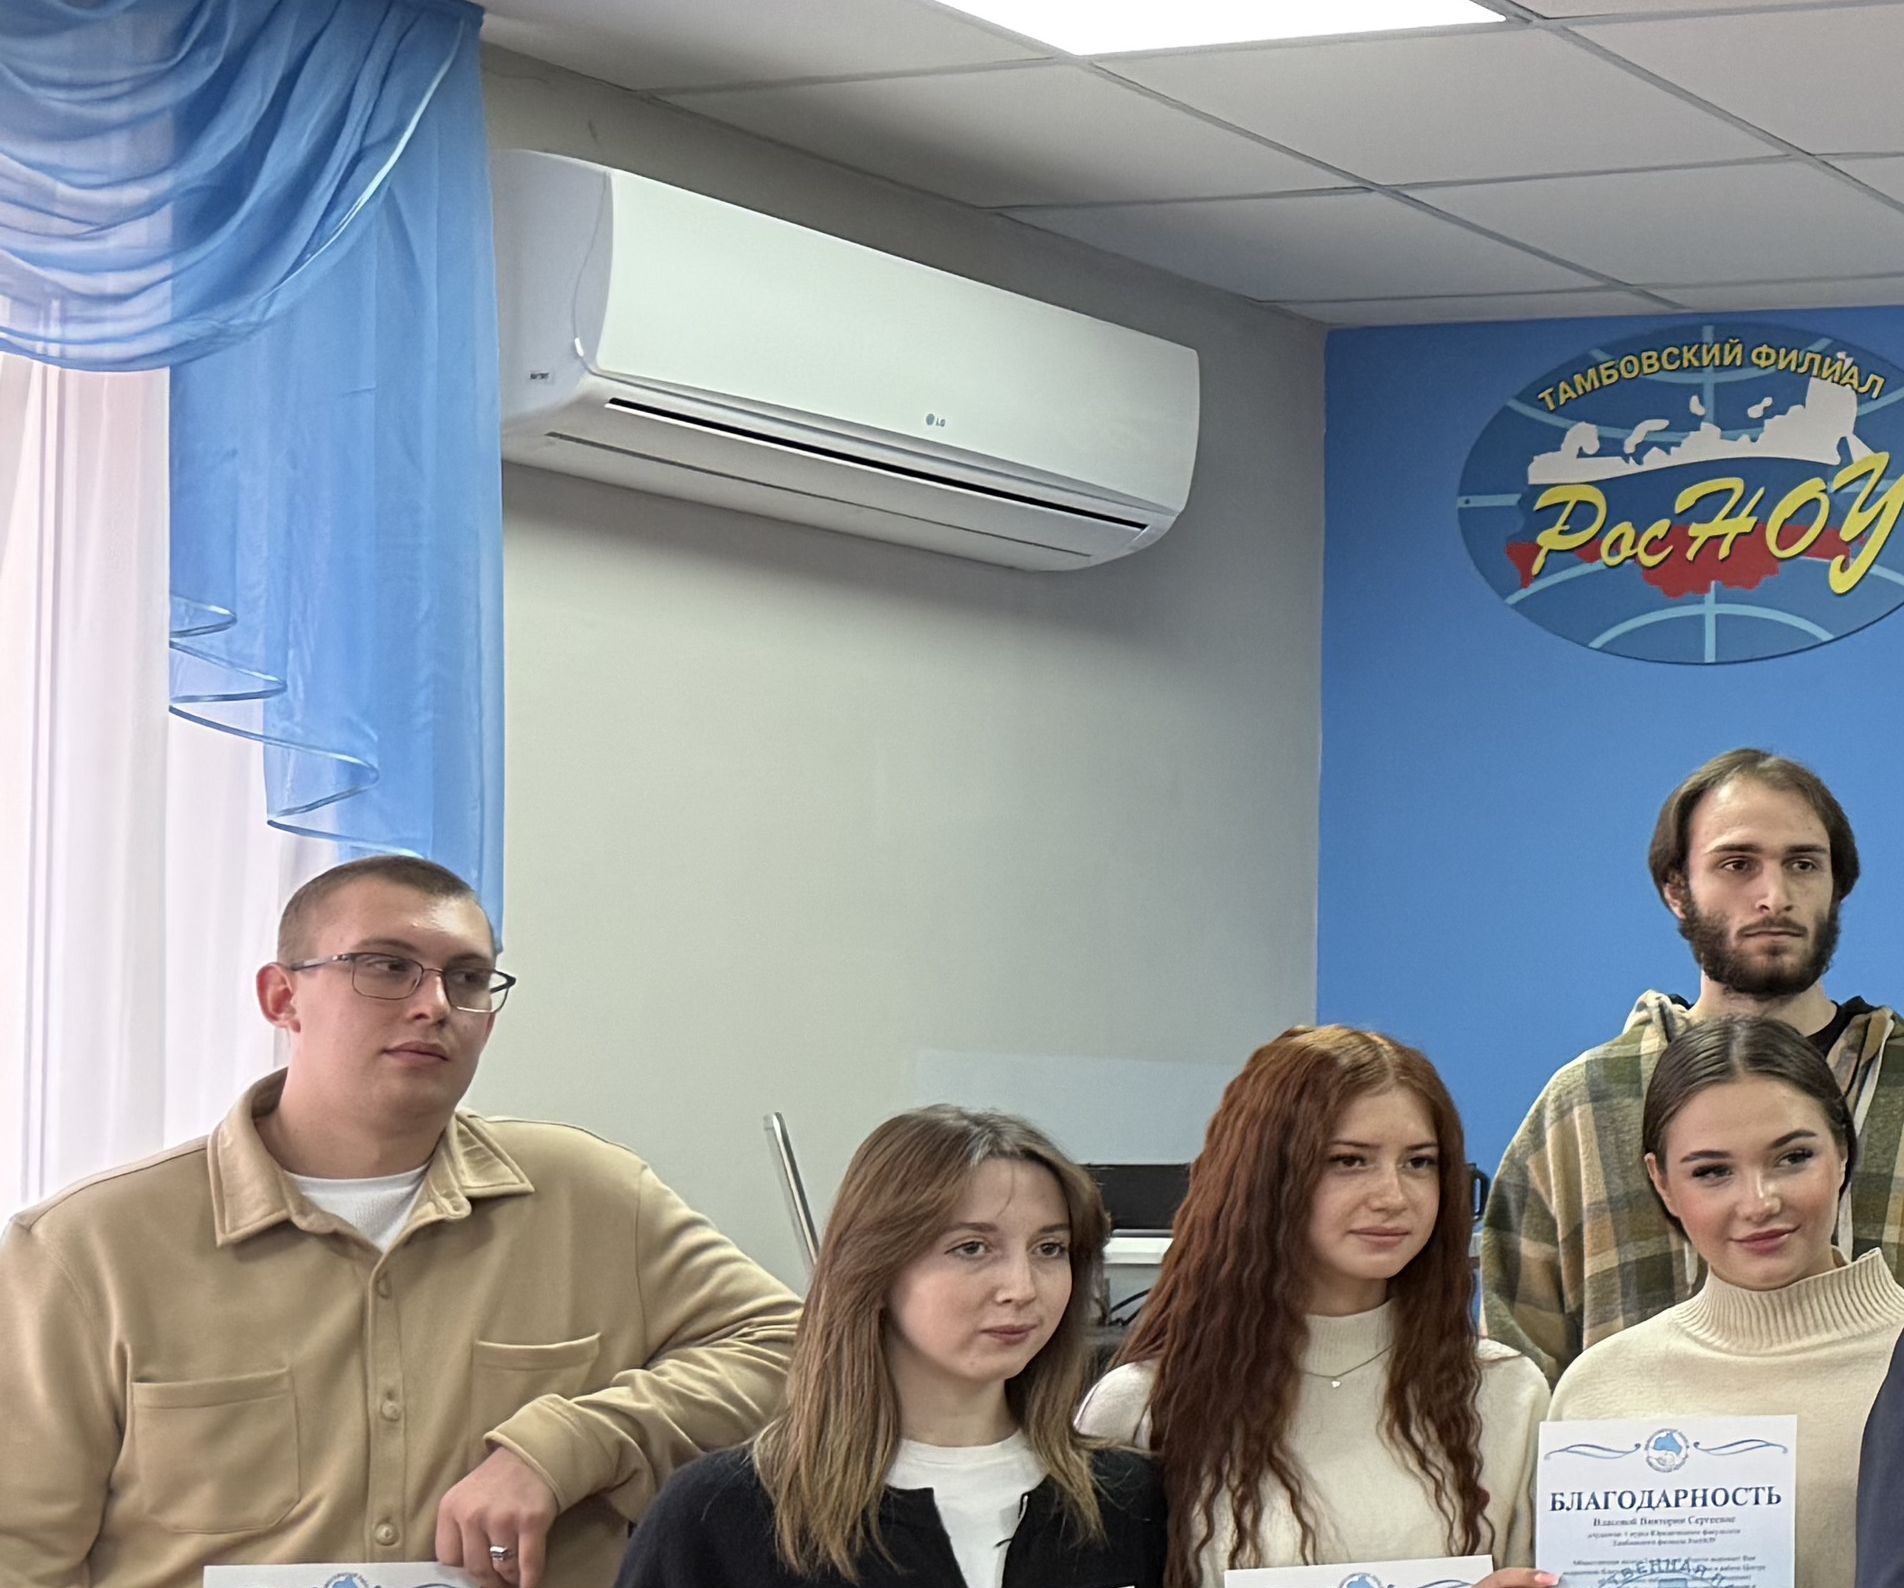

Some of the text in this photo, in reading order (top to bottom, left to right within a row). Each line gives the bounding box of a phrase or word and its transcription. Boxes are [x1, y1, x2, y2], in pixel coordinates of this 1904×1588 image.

[1539, 336, 1886, 412] ТАМБОВСКИЙ ФИЛИАЛ
[1550, 1485, 1782, 1513] БЛАГОДАРНОСТЬ
